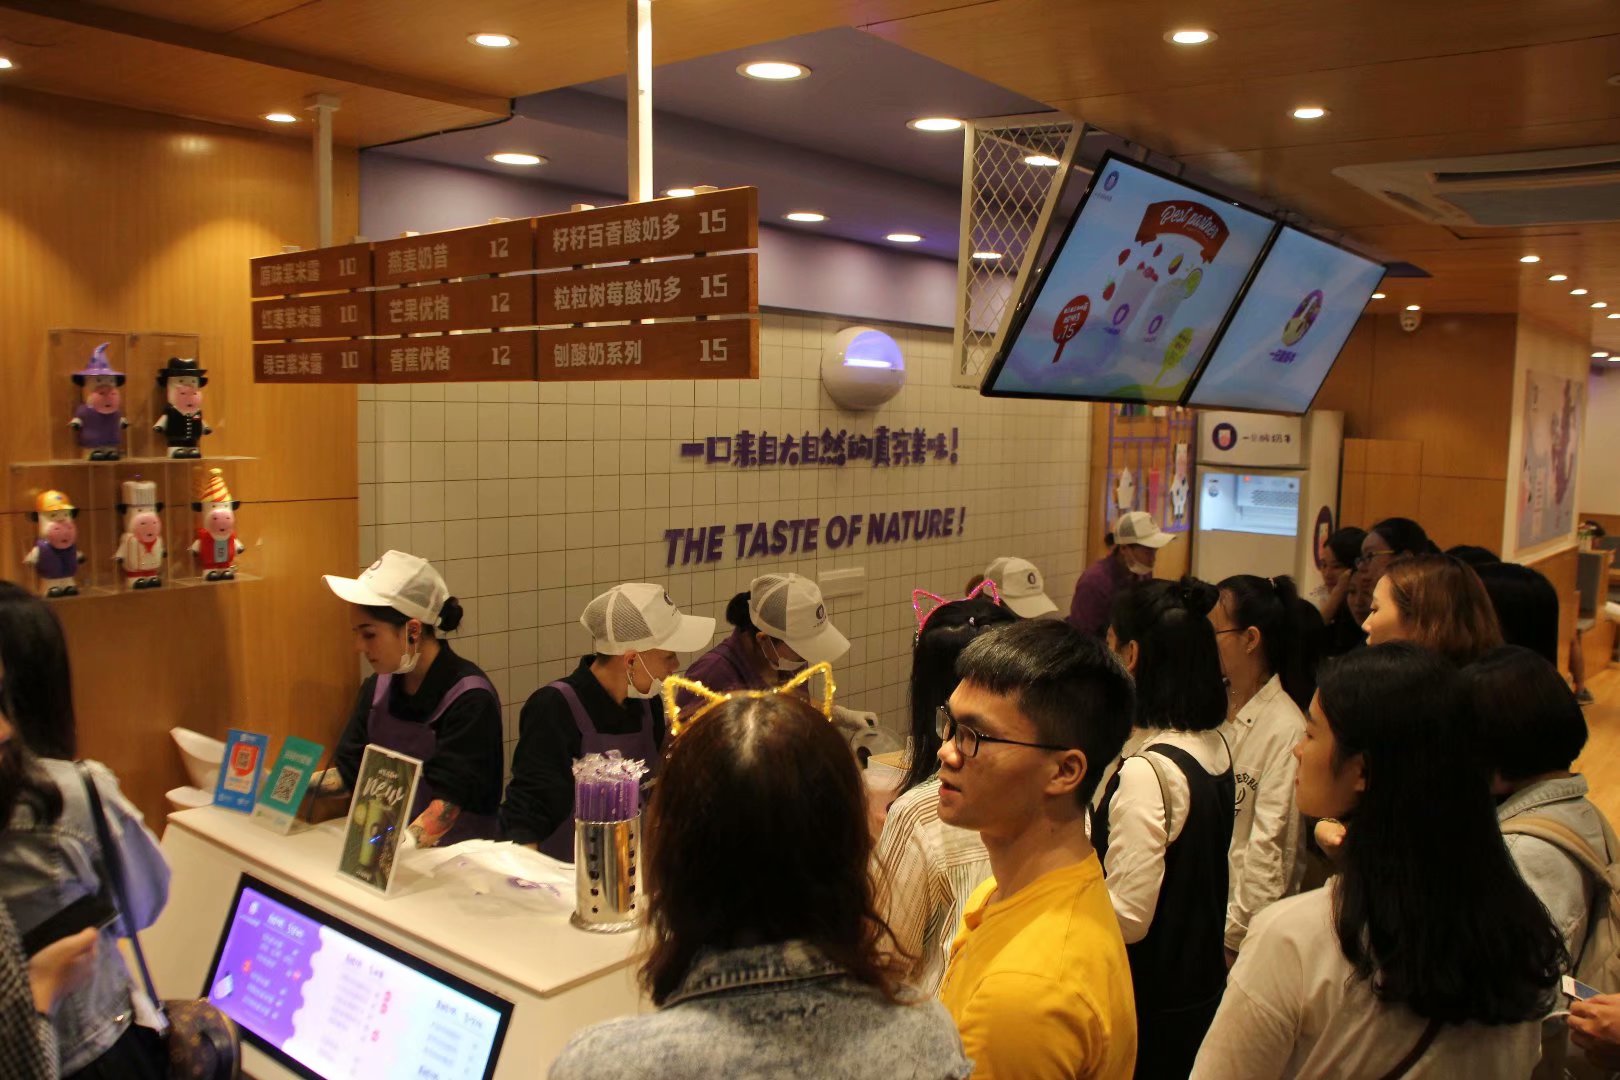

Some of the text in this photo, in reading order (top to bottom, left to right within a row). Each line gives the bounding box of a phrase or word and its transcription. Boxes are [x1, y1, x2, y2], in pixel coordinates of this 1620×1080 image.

[699, 208, 727, 234] 15
[339, 257, 356, 276] 10
[388, 237, 509, 274] 燕麦奶昔 12
[554, 273, 728, 311] 粒粒树莓酸奶多 15
[340, 305, 358, 323] 10
[389, 292, 510, 323] 芒果优格 12
[341, 351, 359, 369] 10
[390, 345, 511, 372] 香蕉优格 12
[553, 337, 728, 368] 刨酸奶系列 15
[664, 525, 726, 568] THE
[735, 518, 821, 560] TASTE
[826, 514, 863, 550] OF
